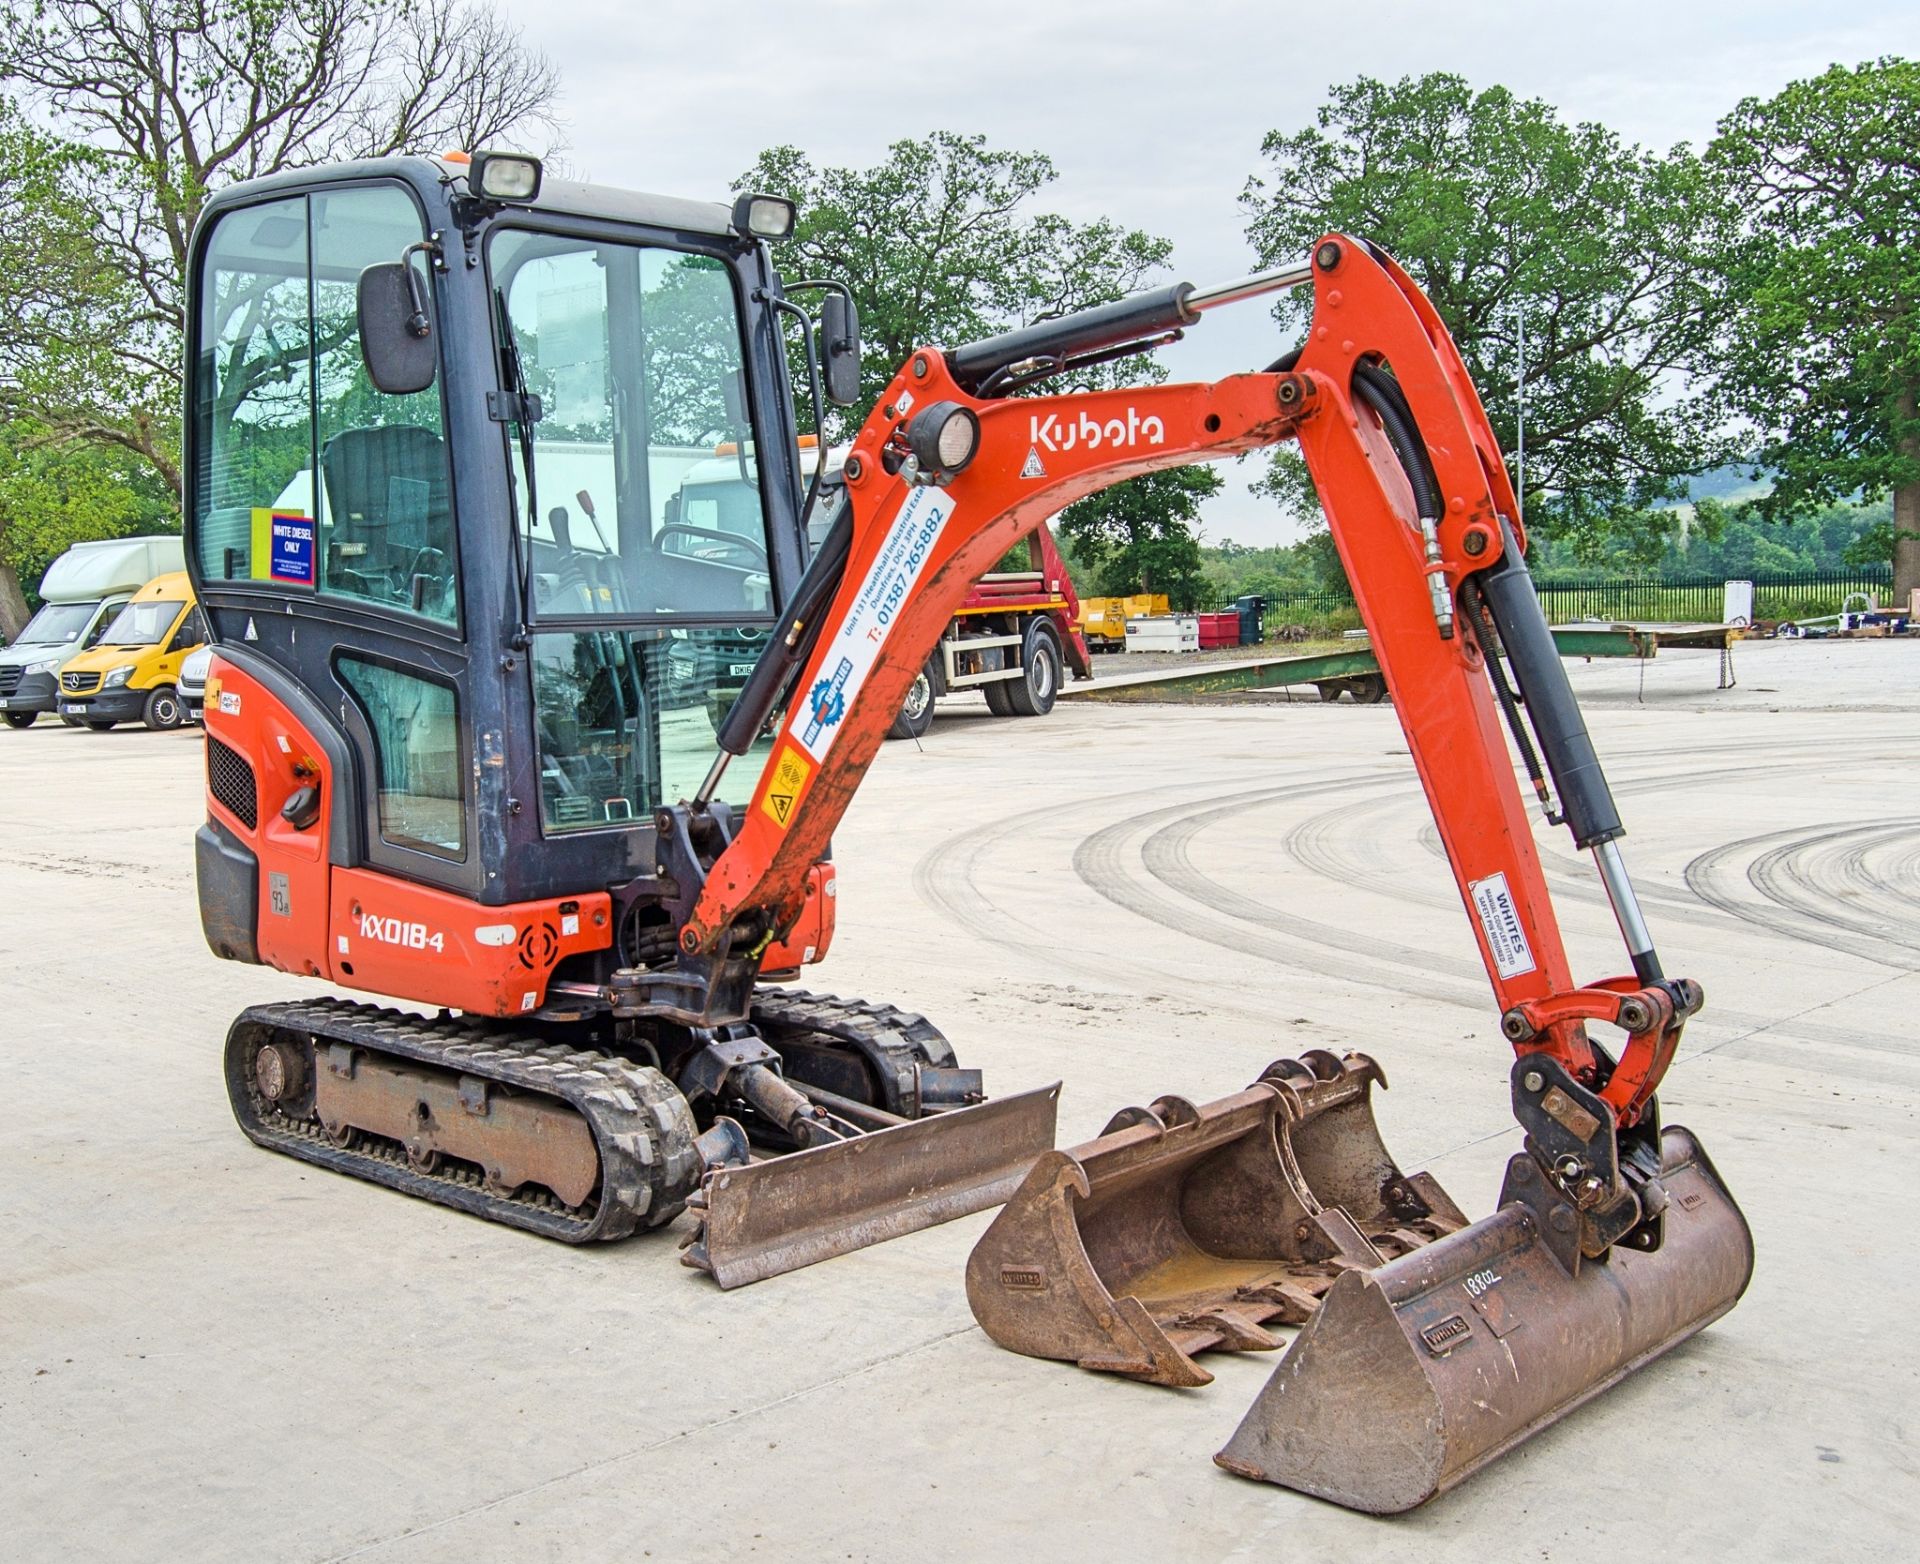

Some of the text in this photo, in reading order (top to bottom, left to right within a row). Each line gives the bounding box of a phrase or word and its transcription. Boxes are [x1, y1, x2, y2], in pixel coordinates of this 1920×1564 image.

[1030, 407, 1164, 452] Kubota
[273, 524, 312, 540] WHITE DIESEL
[284, 541, 300, 554] ONLY
[893, 544, 907, 565] DG1
[905, 522, 918, 544] 3PH
[844, 485, 926, 636] Unit 131 Heathhall Industrial Estat
[867, 507, 943, 643] T: 01387 265882
[804, 659, 851, 746] HIRE SUPPLIES
[272, 890, 284, 911] 93
[360, 913, 444, 953] KX018-4
[1479, 896, 1506, 962] SAFETY PIN REQUIRED
[1485, 888, 1515, 966] MANUAL COUPLER FITTED
[1497, 892, 1524, 954] WHITES
[1462, 1270, 1502, 1298] 18802
[1426, 1320, 1468, 1346] WHITES
